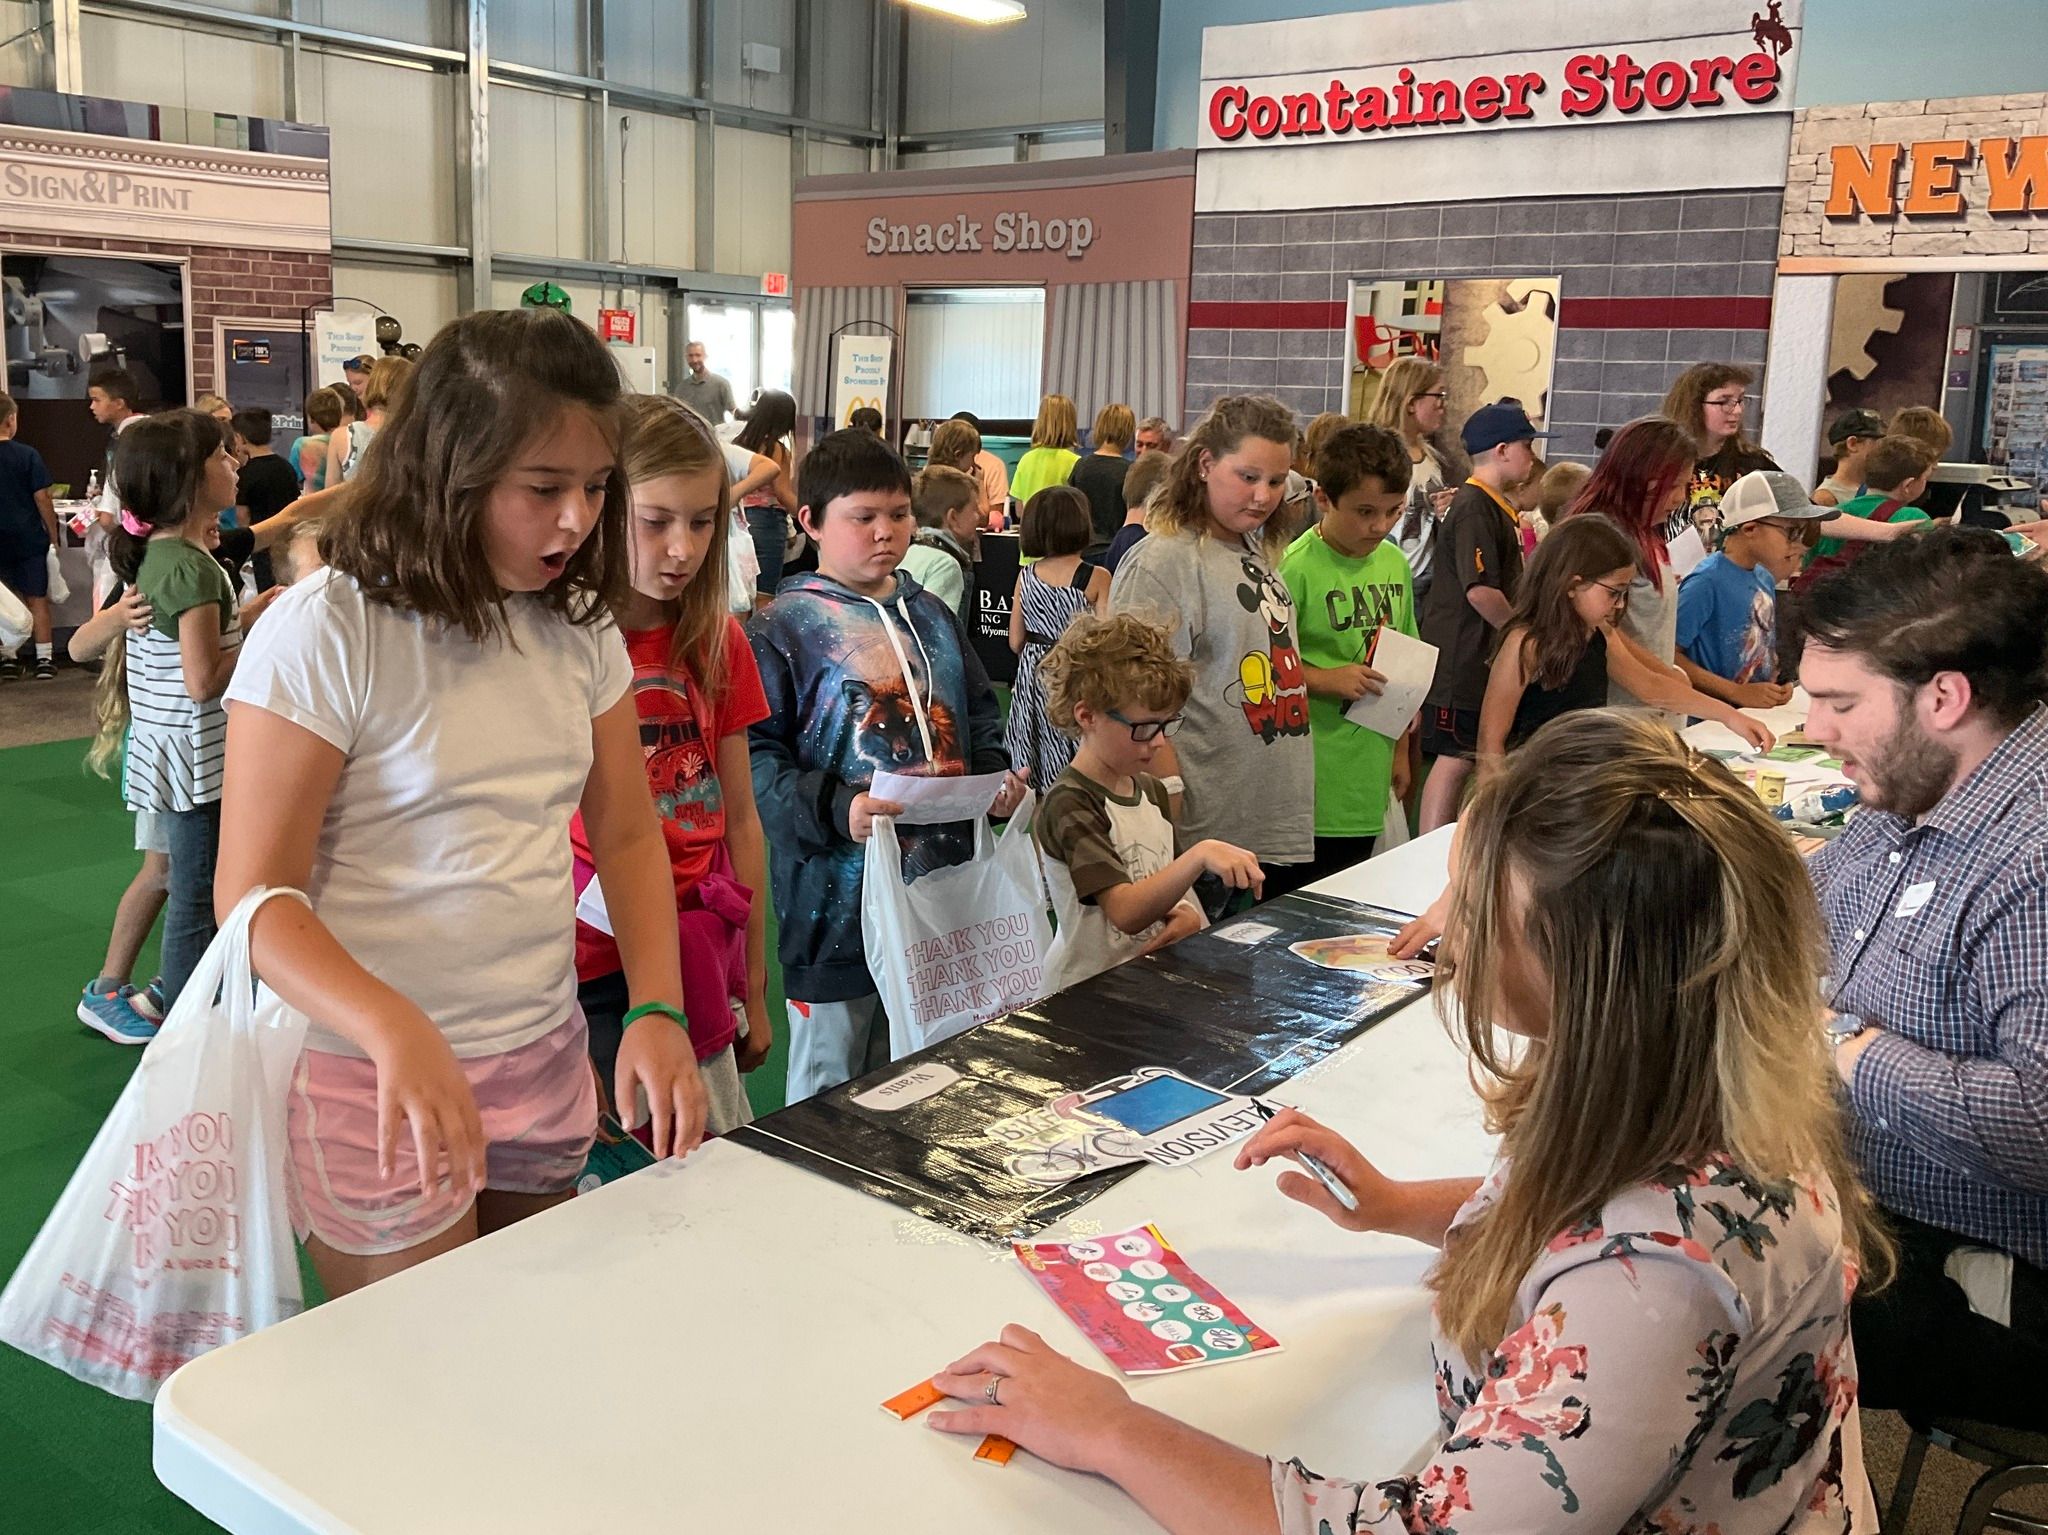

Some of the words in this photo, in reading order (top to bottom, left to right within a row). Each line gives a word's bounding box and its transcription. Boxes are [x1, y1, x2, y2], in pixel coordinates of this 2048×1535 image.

[1207, 67, 1545, 142] Container
[1560, 50, 1781, 117] Store
[866, 214, 982, 254] Snack
[993, 212, 1094, 257] Shop
[905, 927, 976, 971] THANK
[976, 913, 1029, 945] YOU
[907, 954, 983, 999] THANK
[983, 940, 1036, 972] YOU
[910, 983, 992, 1025] THANK
[990, 967, 1042, 1001] YOU
[878, 1073, 936, 1096] Wants
[992, 1111, 1060, 1142] BIKE
